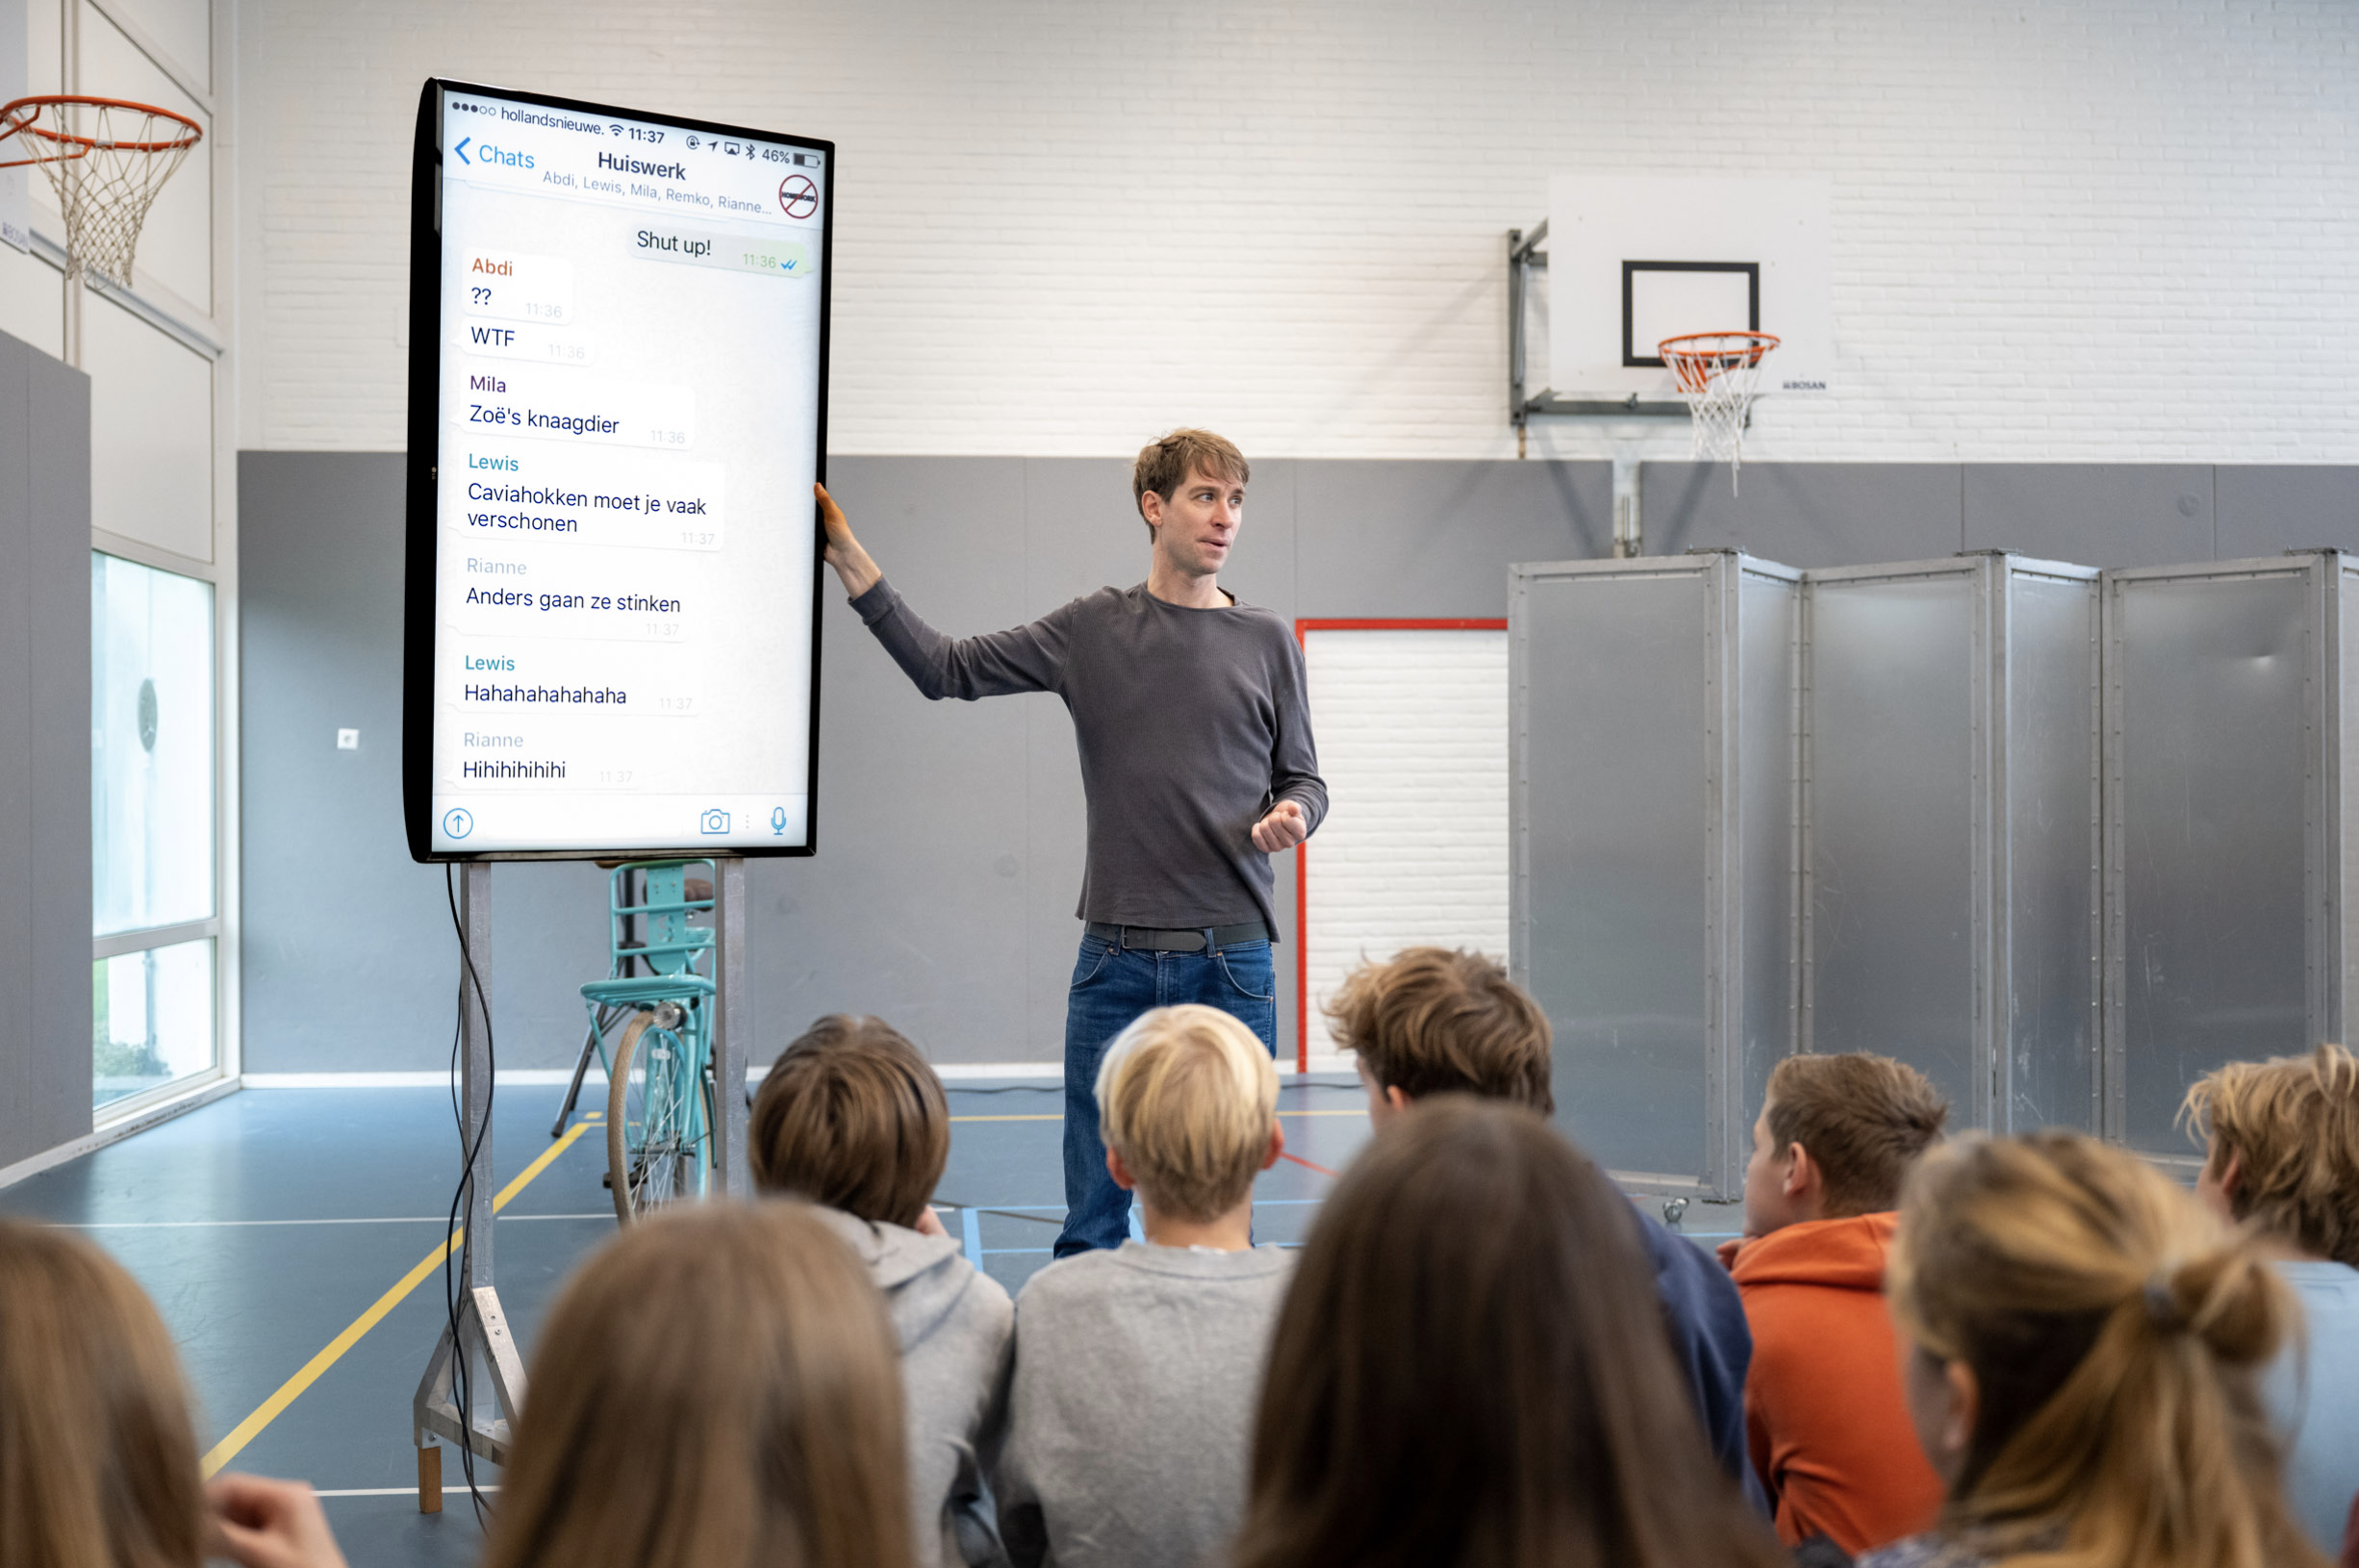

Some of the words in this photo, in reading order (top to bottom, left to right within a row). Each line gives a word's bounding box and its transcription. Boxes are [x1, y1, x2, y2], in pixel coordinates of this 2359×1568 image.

[501, 106, 606, 135] hollandsnieuwe.
[628, 127, 665, 145] 11:37
[762, 148, 790, 164] 46%
[478, 144, 535, 169] Chats
[597, 151, 687, 182] Huiswerk
[543, 170, 578, 190] Abdi,
[583, 176, 625, 195] Lewis,
[630, 183, 662, 202] Mila,
[666, 188, 714, 210] Remko,
[637, 230, 679, 252] Shut
[683, 239, 711, 259] up!
[471, 257, 513, 277] Abdi
[743, 253, 776, 269] 11:36
[470, 287, 492, 306] ??
[525, 302, 563, 319] 11:36
[470, 326, 516, 347] WTF
[548, 344, 585, 360] 11:36
[469, 374, 506, 393] Mila
[469, 404, 521, 426] Zoë's
[527, 409, 621, 436] knaagdier
[649, 429, 686, 445] 11:36
[469, 452, 520, 472] Lewis
[468, 482, 588, 507] Caviahokken
[594, 494, 641, 511] moet
[644, 493, 661, 516] je
[666, 497, 707, 516] vaak
[467, 512, 577, 533] verschonen
[680, 531, 716, 545] 11:37
[467, 557, 527, 575] Rianne
[466, 587, 533, 607] Anders
[539, 594, 584, 612] gaan
[590, 595, 612, 610] ze
[617, 594, 681, 613] stinken
[646, 622, 680, 637] 11:37
[465, 654, 516, 671] Lewis
[465, 683, 626, 704] Hahahahahahaha
[659, 696, 693, 711] 1137
[464, 731, 524, 748] Rianne
[463, 760, 566, 778] Hihihihihihi
[598, 770, 633, 783] 1137
